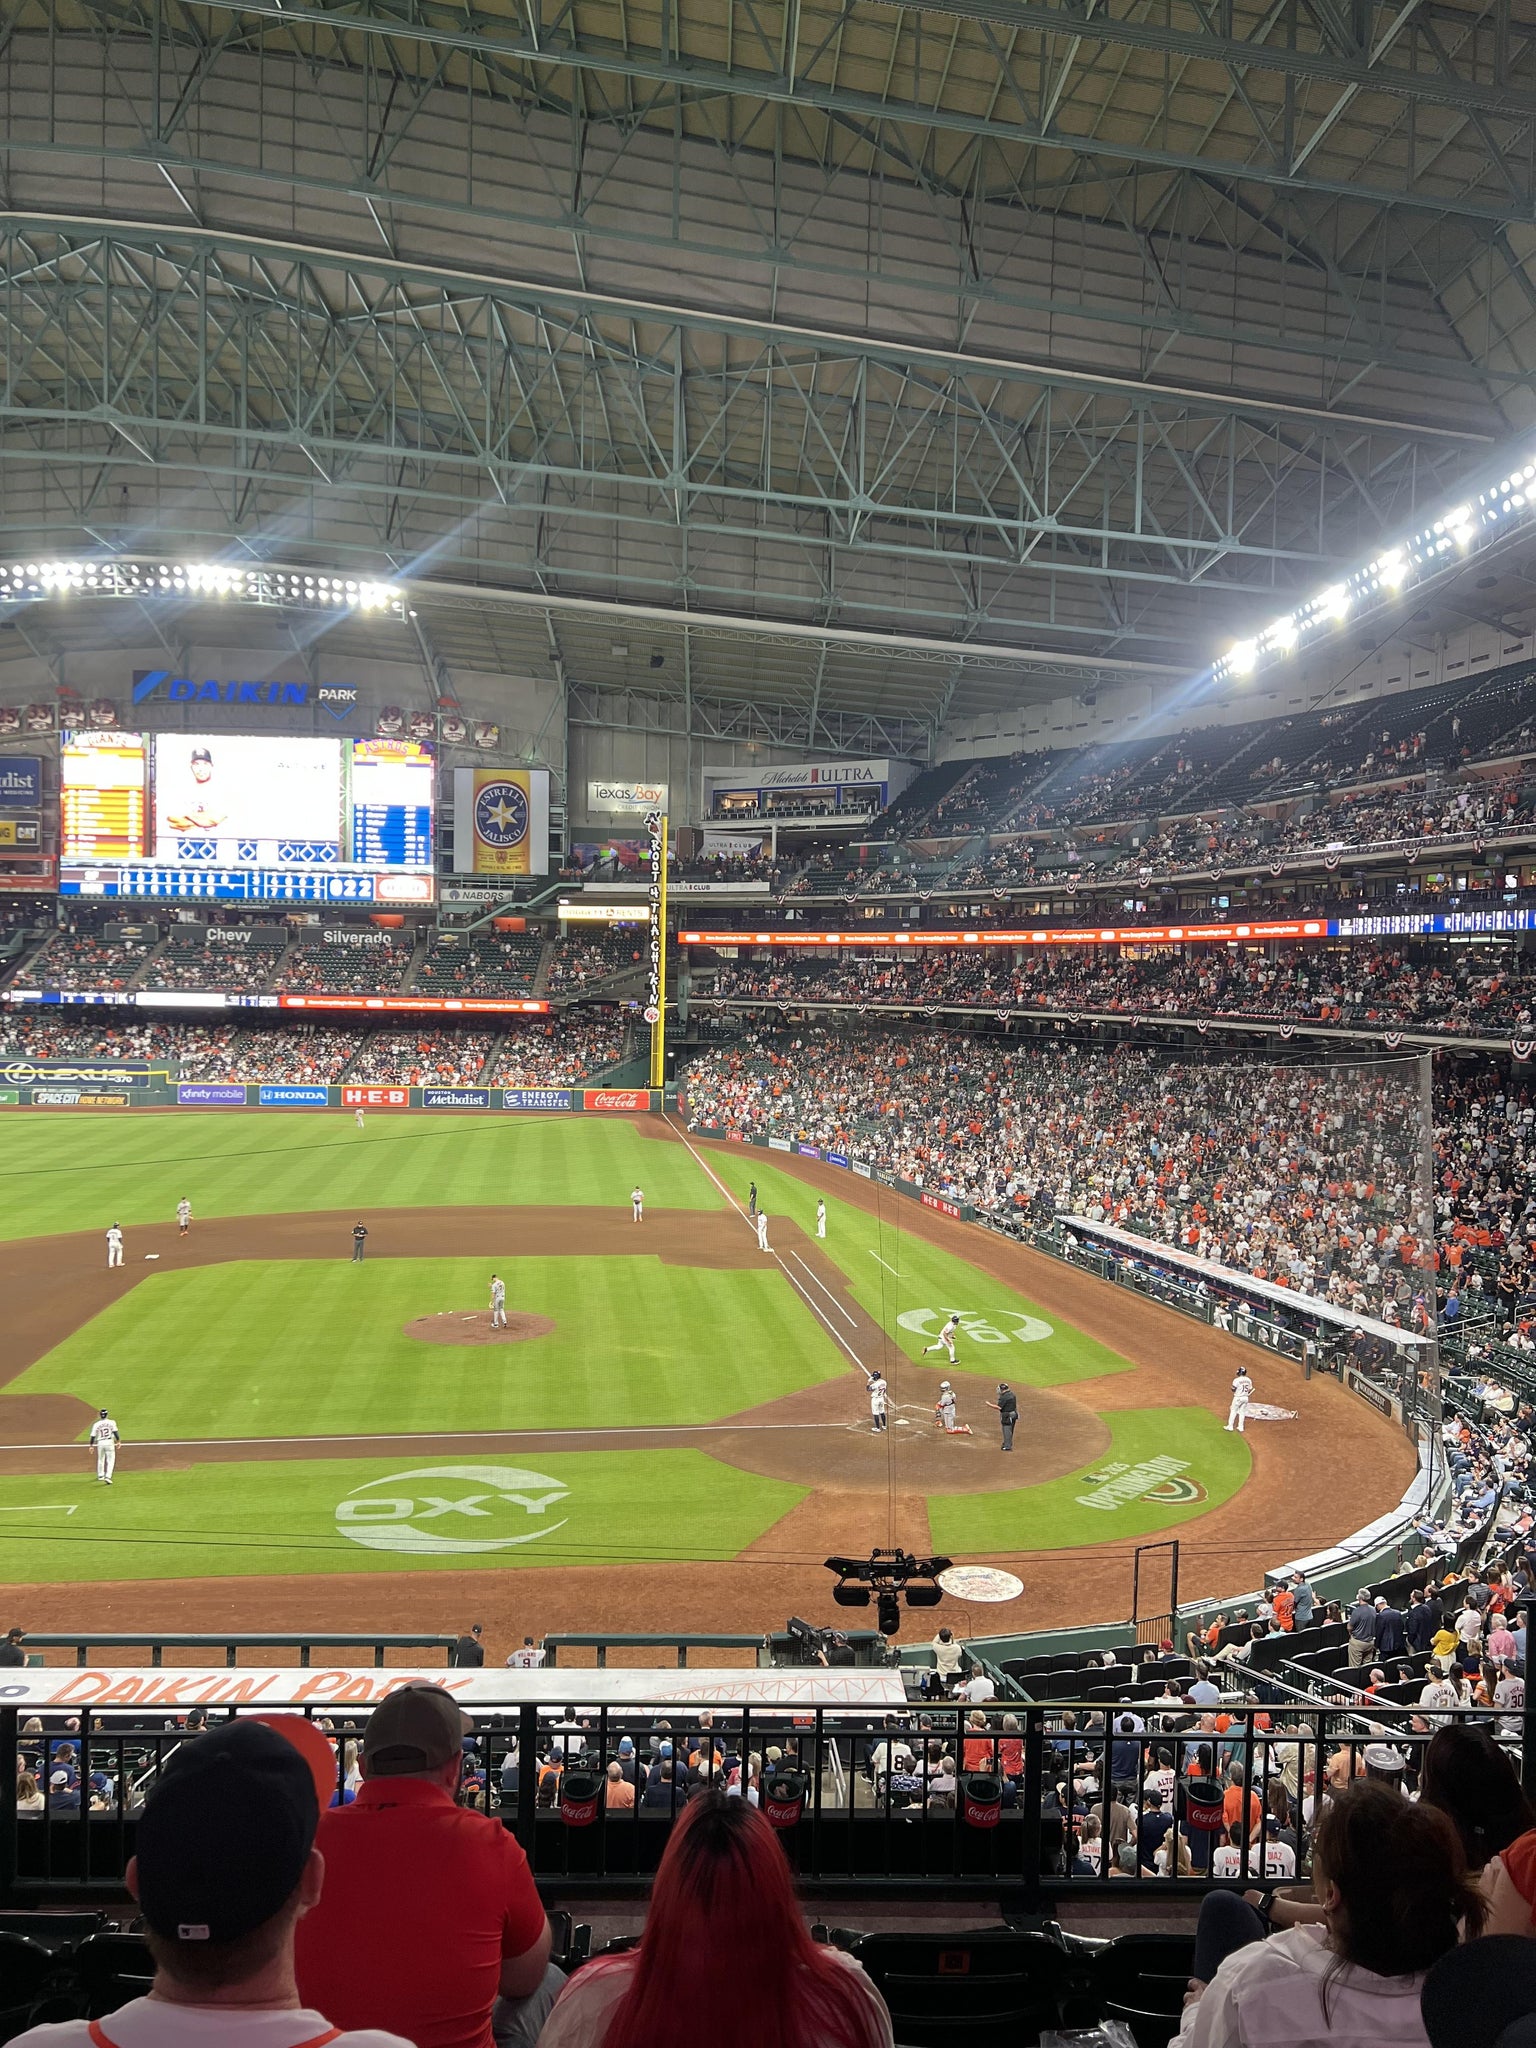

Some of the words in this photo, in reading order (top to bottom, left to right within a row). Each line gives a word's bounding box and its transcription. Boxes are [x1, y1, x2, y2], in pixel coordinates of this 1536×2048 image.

[168, 679, 309, 704] DAIKIN
[318, 689, 358, 700] PARK
[480, 722, 493, 737] 7
[365, 740, 409, 755] ASTROS
[760, 771, 809, 785] Michelob
[821, 767, 874, 782] ULTRA
[480, 787, 524, 806] ESTRELLA
[593, 784, 630, 799] Texas
[636, 786, 662, 804] Bay
[17, 828, 37, 839] CAT
[483, 828, 522, 842] JALISCO
[343, 879, 356, 897] 2
[358, 880, 372, 897] 2
[462, 891, 504, 900] NABORS
[1444, 916, 1452, 929] R
[1464, 916, 1472, 928] H
[1485, 914, 1493, 928] E
[1507, 914, 1514, 927] L
[206, 928, 252, 943] Chevy
[323, 930, 392, 945] Silverado
[38, 1068, 127, 1081] LEXUS
[37, 1093, 61, 1105] SPACE
[61, 1093, 80, 1104] CITY
[181, 1089, 211, 1100] xfinity
[212, 1089, 243, 1099] mobile
[274, 1091, 326, 1100] HONDA
[427, 1091, 484, 1106] Methodist
[522, 1091, 560, 1100] ENERGY
[522, 1099, 569, 1107] TRANSFER
[100, 1428, 109, 1438] 12
[1074, 1469, 1170, 1511] OPENING
[1133, 1454, 1192, 1477] DAY
[335, 1492, 573, 1521] OXY
[523, 1658, 531, 1668] 9
[46, 1672, 281, 1704] DAIKIN
[1511, 1693, 1524, 1708] 30
[1267, 1851, 1282, 1861] DIAZ
